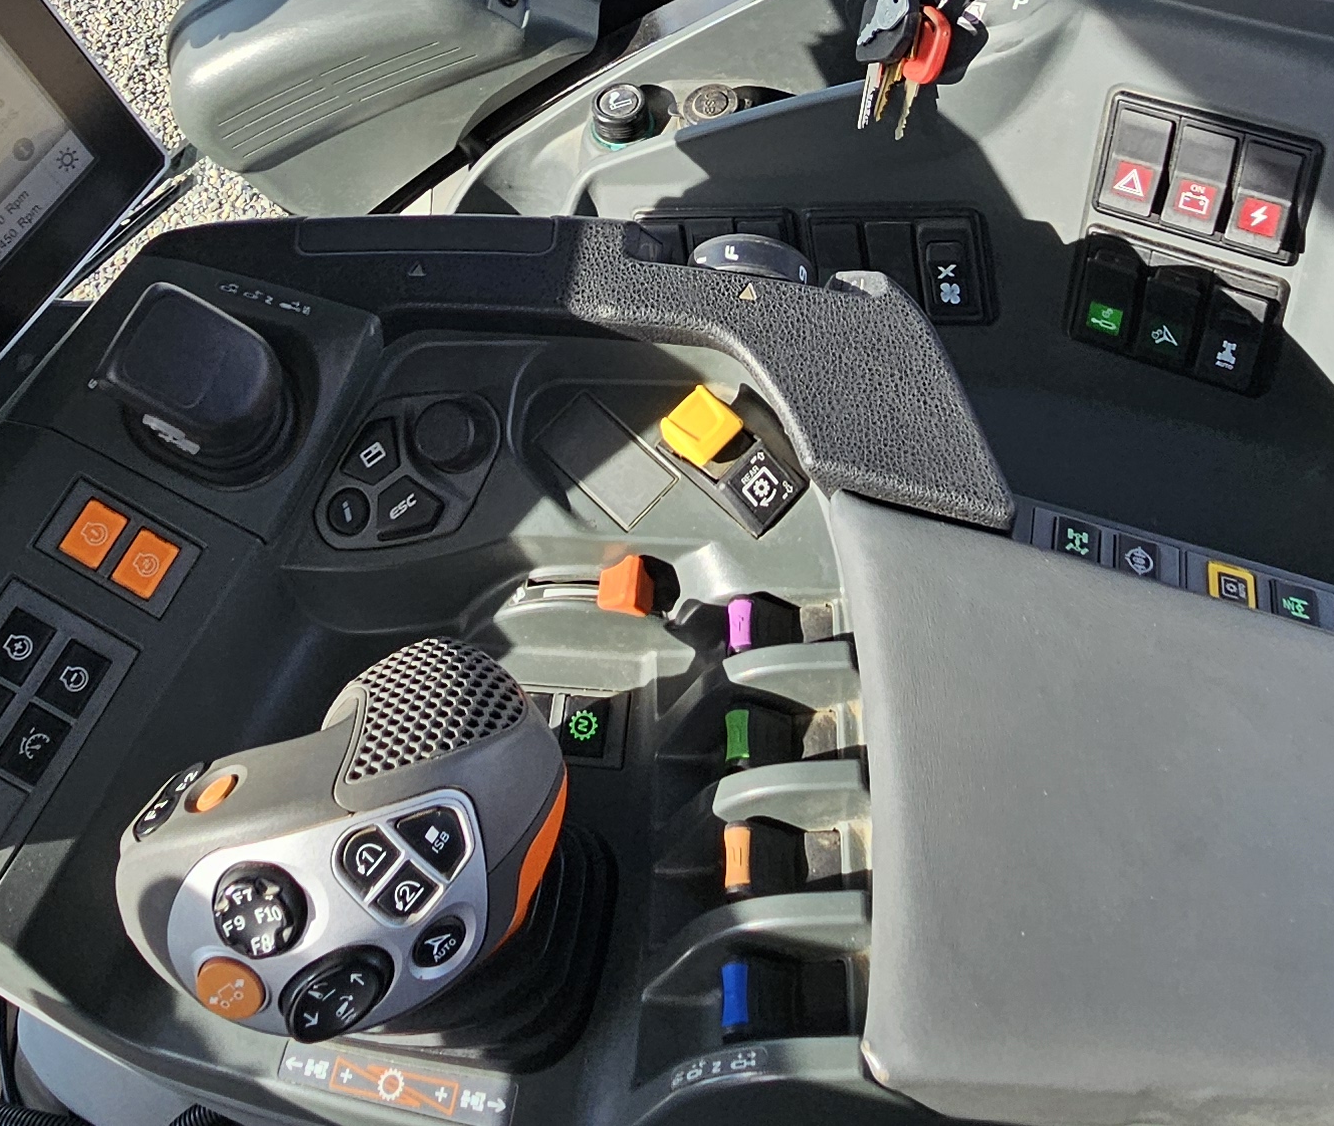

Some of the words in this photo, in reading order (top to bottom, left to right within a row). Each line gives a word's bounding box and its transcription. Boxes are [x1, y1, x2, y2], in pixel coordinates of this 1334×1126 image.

[1189, 183, 1207, 195] ON
[3, 189, 31, 217] Rpm
[15, 203, 44, 232] Rpm
[1215, 359, 1235, 371] AUTO
[740, 464, 760, 485] REAR
[389, 493, 417, 520] ESC
[144, 799, 169, 822] F1
[431, 830, 450, 854] ISB
[232, 887, 253, 905] F7
[399, 885, 416, 903] 2
[222, 915, 246, 938] F9
[253, 905, 282, 925] F10
[250, 933, 275, 956] F8
[433, 938, 457, 963] AUTO
